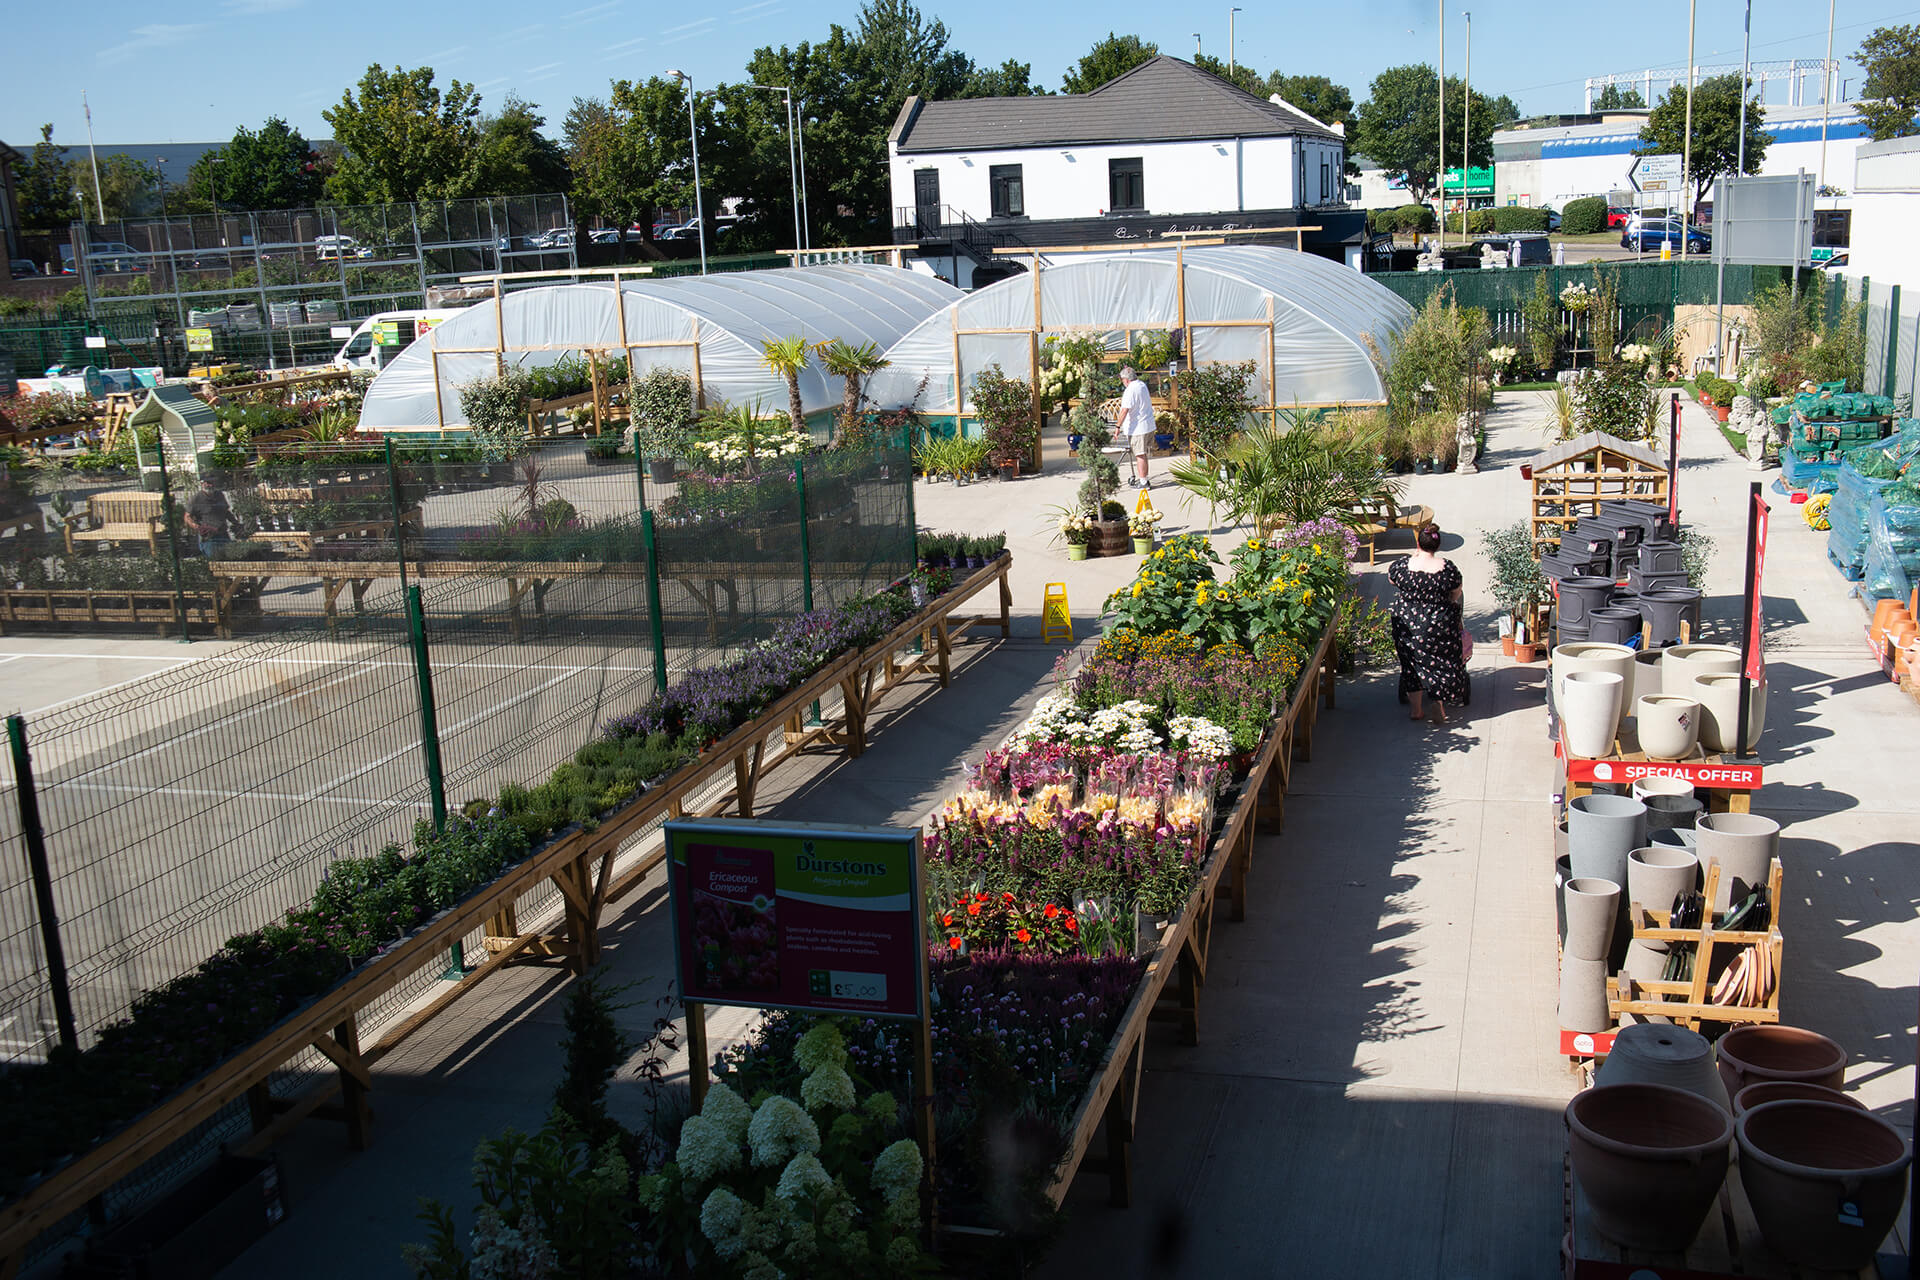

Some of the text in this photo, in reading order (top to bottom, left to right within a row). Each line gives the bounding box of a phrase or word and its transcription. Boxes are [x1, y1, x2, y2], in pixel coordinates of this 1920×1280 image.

[1443, 171, 1460, 182] pets
[1469, 171, 1490, 181] home
[1625, 766, 1694, 781] SPECIAL
[1698, 769, 1753, 783] OFFER
[797, 856, 887, 876] Durstons
[709, 871, 759, 884] Ericaceous
[709, 881, 749, 894] Compost
